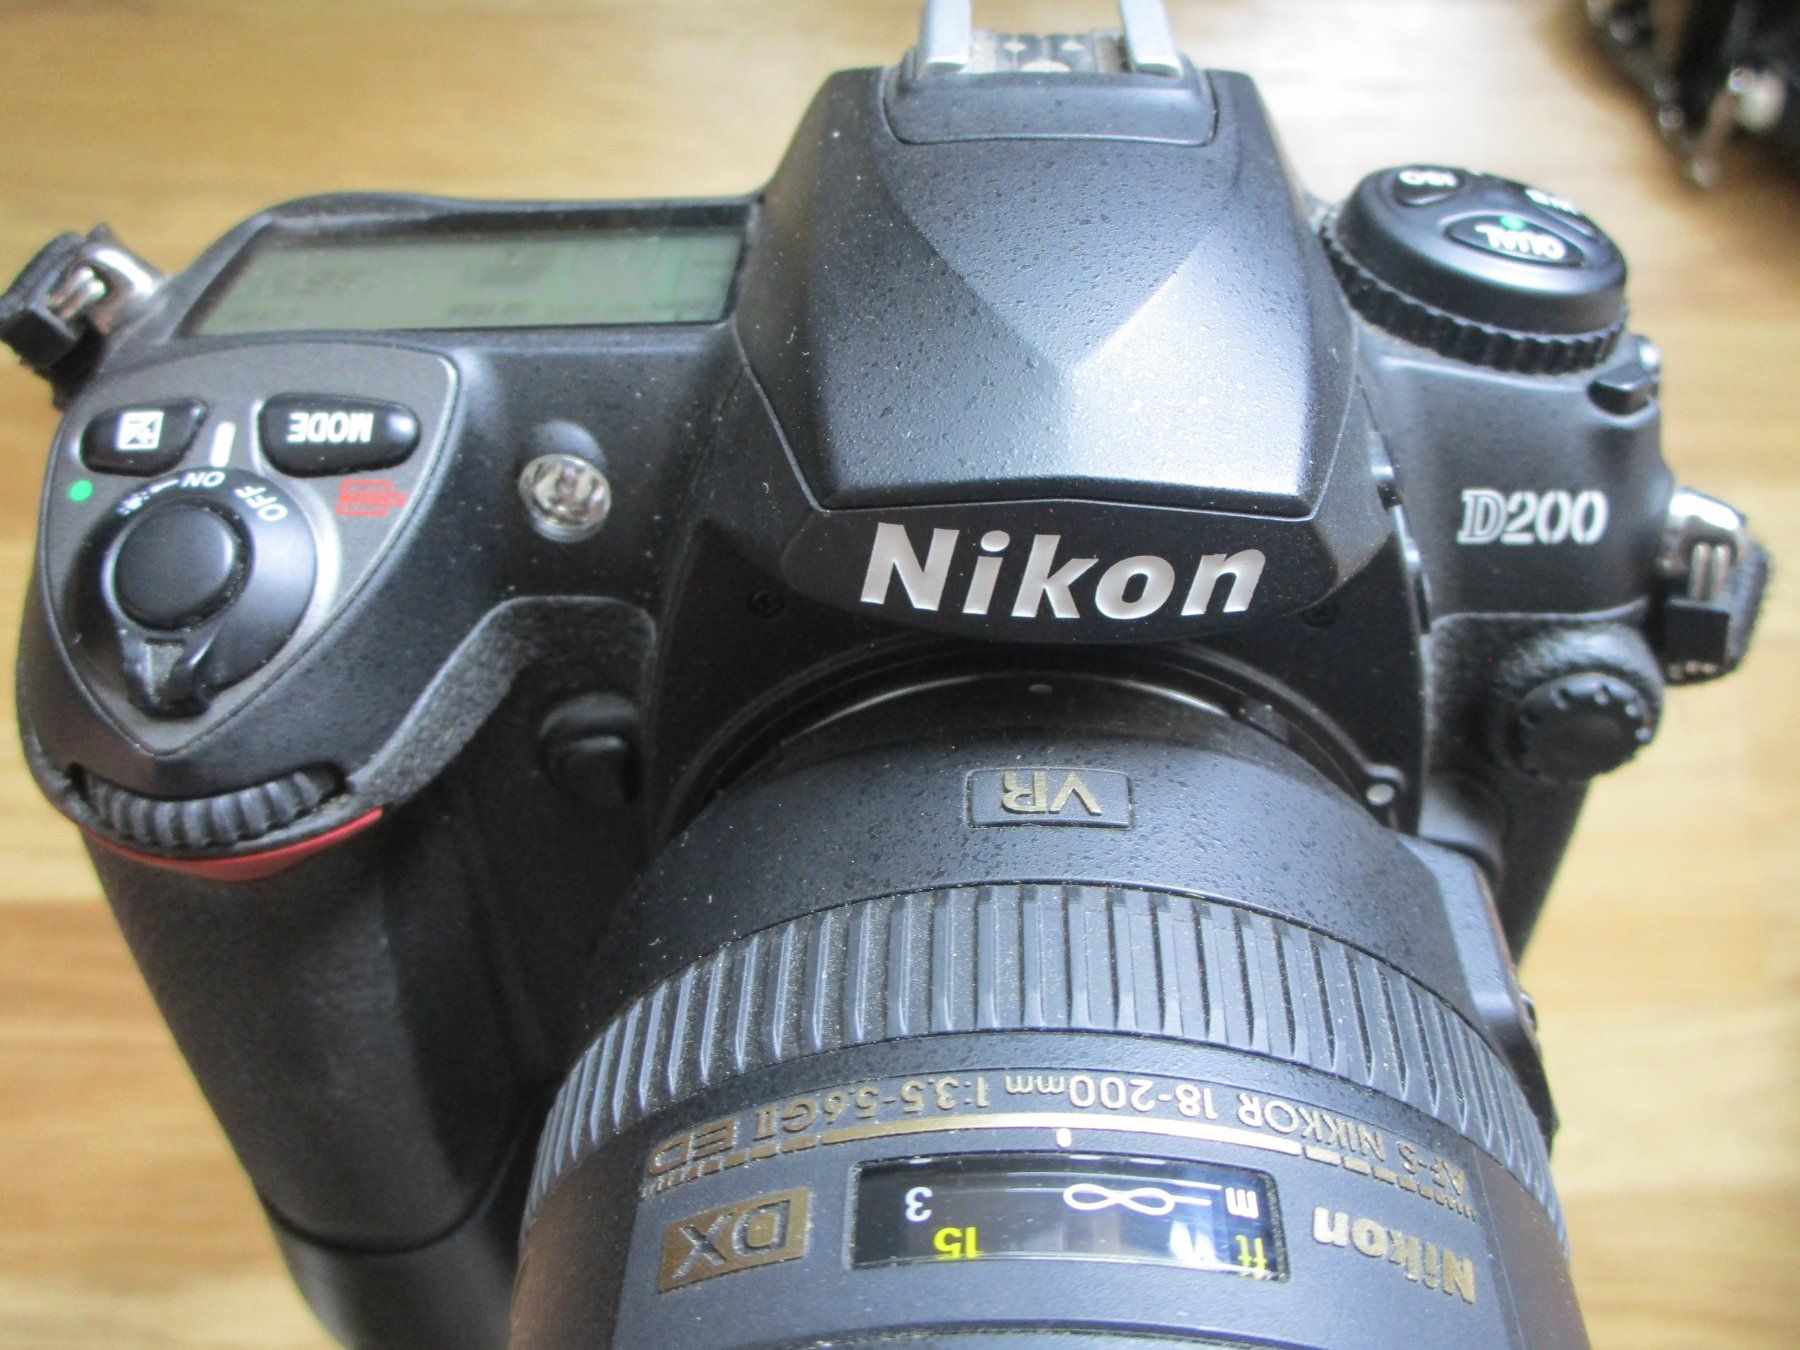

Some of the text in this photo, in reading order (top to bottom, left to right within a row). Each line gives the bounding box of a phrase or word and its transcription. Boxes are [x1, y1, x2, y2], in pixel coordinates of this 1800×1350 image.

[1474, 224, 1566, 259] QUAL
[286, 412, 374, 443] MODE
[179, 471, 226, 488] ON
[234, 484, 288, 522] OFF
[1457, 488, 1608, 545] D200
[860, 521, 1266, 620] Nikon
[1001, 771, 1103, 817] VR
[1003, 1074, 1218, 1120] 18-200mm
[647, 1118, 739, 1176] ED
[1237, 1092, 1385, 1162] NIKKOR
[904, 1186, 933, 1223] 3
[1224, 1187, 1259, 1220] m
[672, 1200, 790, 1280] DX
[933, 1226, 981, 1259] 15
[1234, 1234, 1267, 1279] ft
[1312, 1206, 1476, 1305] Nikon
